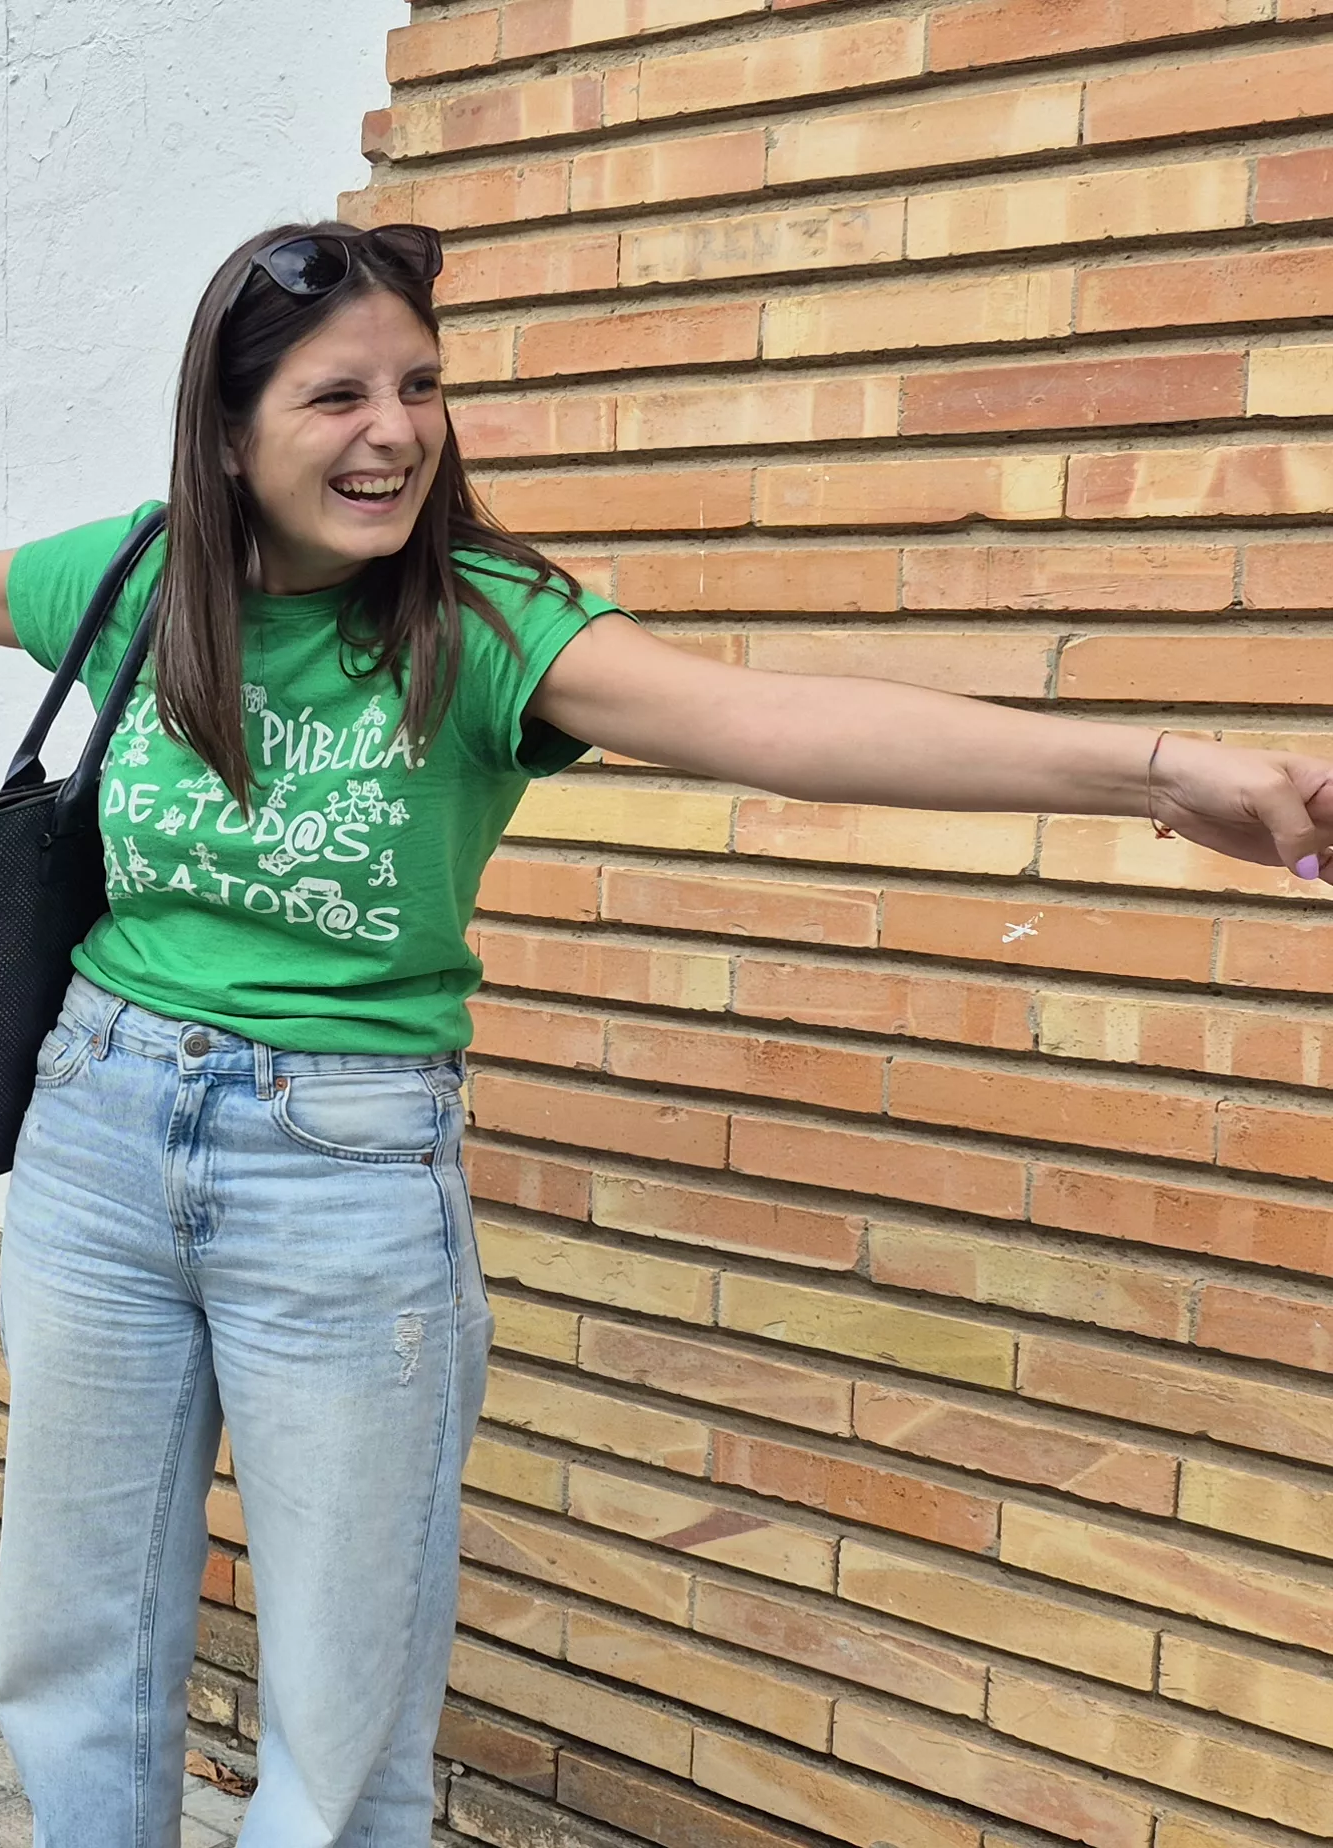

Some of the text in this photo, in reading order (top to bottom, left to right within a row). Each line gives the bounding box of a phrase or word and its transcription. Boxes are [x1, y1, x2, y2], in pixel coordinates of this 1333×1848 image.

[260, 706, 426, 775] PÚBLICA:
[104, 778, 370, 862] DE TOD@S
[107, 850, 400, 941] ARA TOD@S
